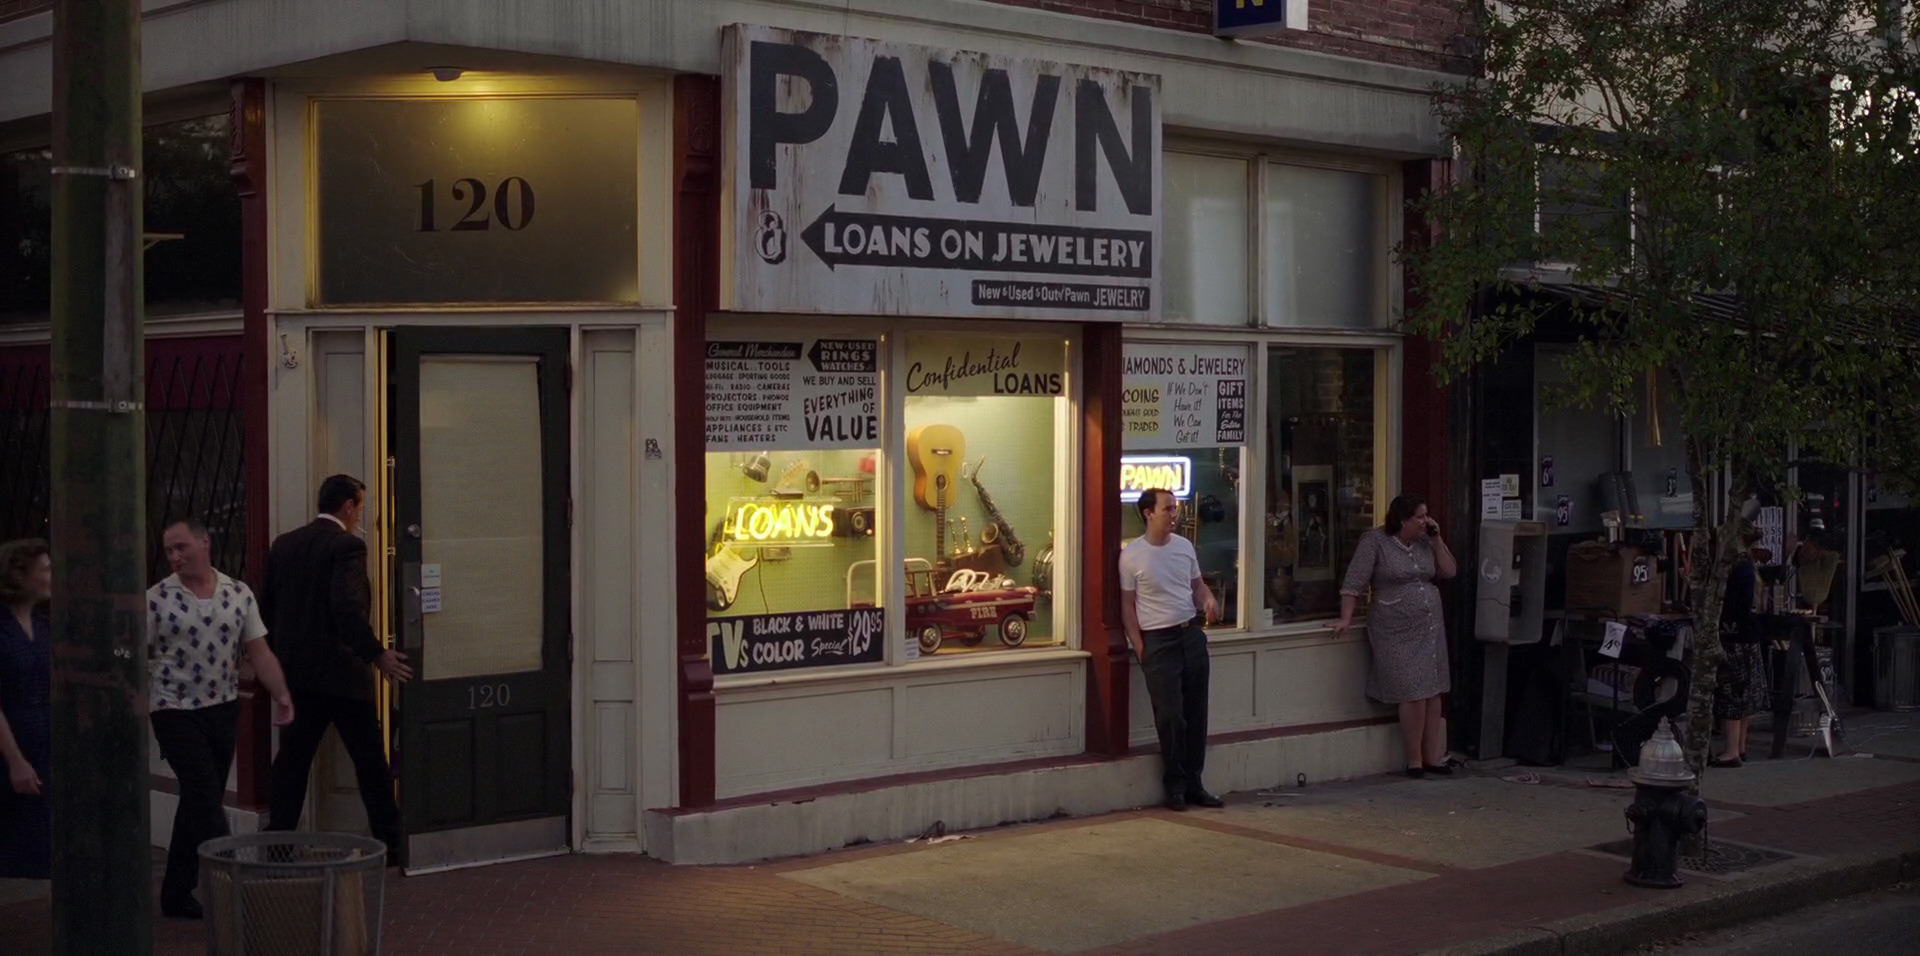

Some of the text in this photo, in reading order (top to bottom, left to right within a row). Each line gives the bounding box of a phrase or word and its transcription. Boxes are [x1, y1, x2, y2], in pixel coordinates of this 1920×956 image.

[750, 41, 1153, 216] PAWN
[412, 176, 535, 232] 120
[825, 222, 931, 258] LOANS
[941, 229, 984, 260] ON
[992, 232, 1145, 268] JEWELERY
[979, 283, 1000, 300] New
[1009, 285, 1034, 301] Used
[1065, 287, 1090, 303] Pawn
[1093, 287, 1146, 308] JEWELRY
[821, 350, 871, 361] RINGS
[706, 361, 790, 371] MUSICAL TOOLS
[821, 361, 865, 371] WATCHES
[906, 342, 1021, 393] Confidential
[1122, 357, 1173, 375] IAMONDS
[1178, 359, 1186, 374] &
[757, 383, 790, 391] CAMERAS
[803, 376, 876, 386] WE BUY AND SELL
[994, 373, 1062, 394] LOANS
[1218, 381, 1244, 396] GIFT
[705, 393, 757, 401] PROJECTORS
[803, 387, 874, 416] EVERYTHING
[1122, 389, 1159, 403] COINS
[1218, 397, 1244, 410] ITEMS
[706, 403, 782, 411] OFFICE EQUIPMENT
[862, 402, 875, 413] OF
[706, 424, 762, 433] APPLIANCES
[804, 415, 877, 441] VALUE
[1129, 421, 1159, 431] TRADED
[737, 434, 776, 442] HEATERS
[1217, 429, 1244, 441] FAMILY
[1122, 464, 1183, 490] PAWN
[735, 503, 835, 541] LOANS
[1633, 565, 1648, 582] 95
[970, 606, 998, 619] FIRE
[753, 616, 791, 635] BLACK
[795, 616, 804, 633] &
[808, 613, 845, 631] WHITE
[753, 636, 847, 665] COLOR Special
[466, 683, 511, 708] 120
